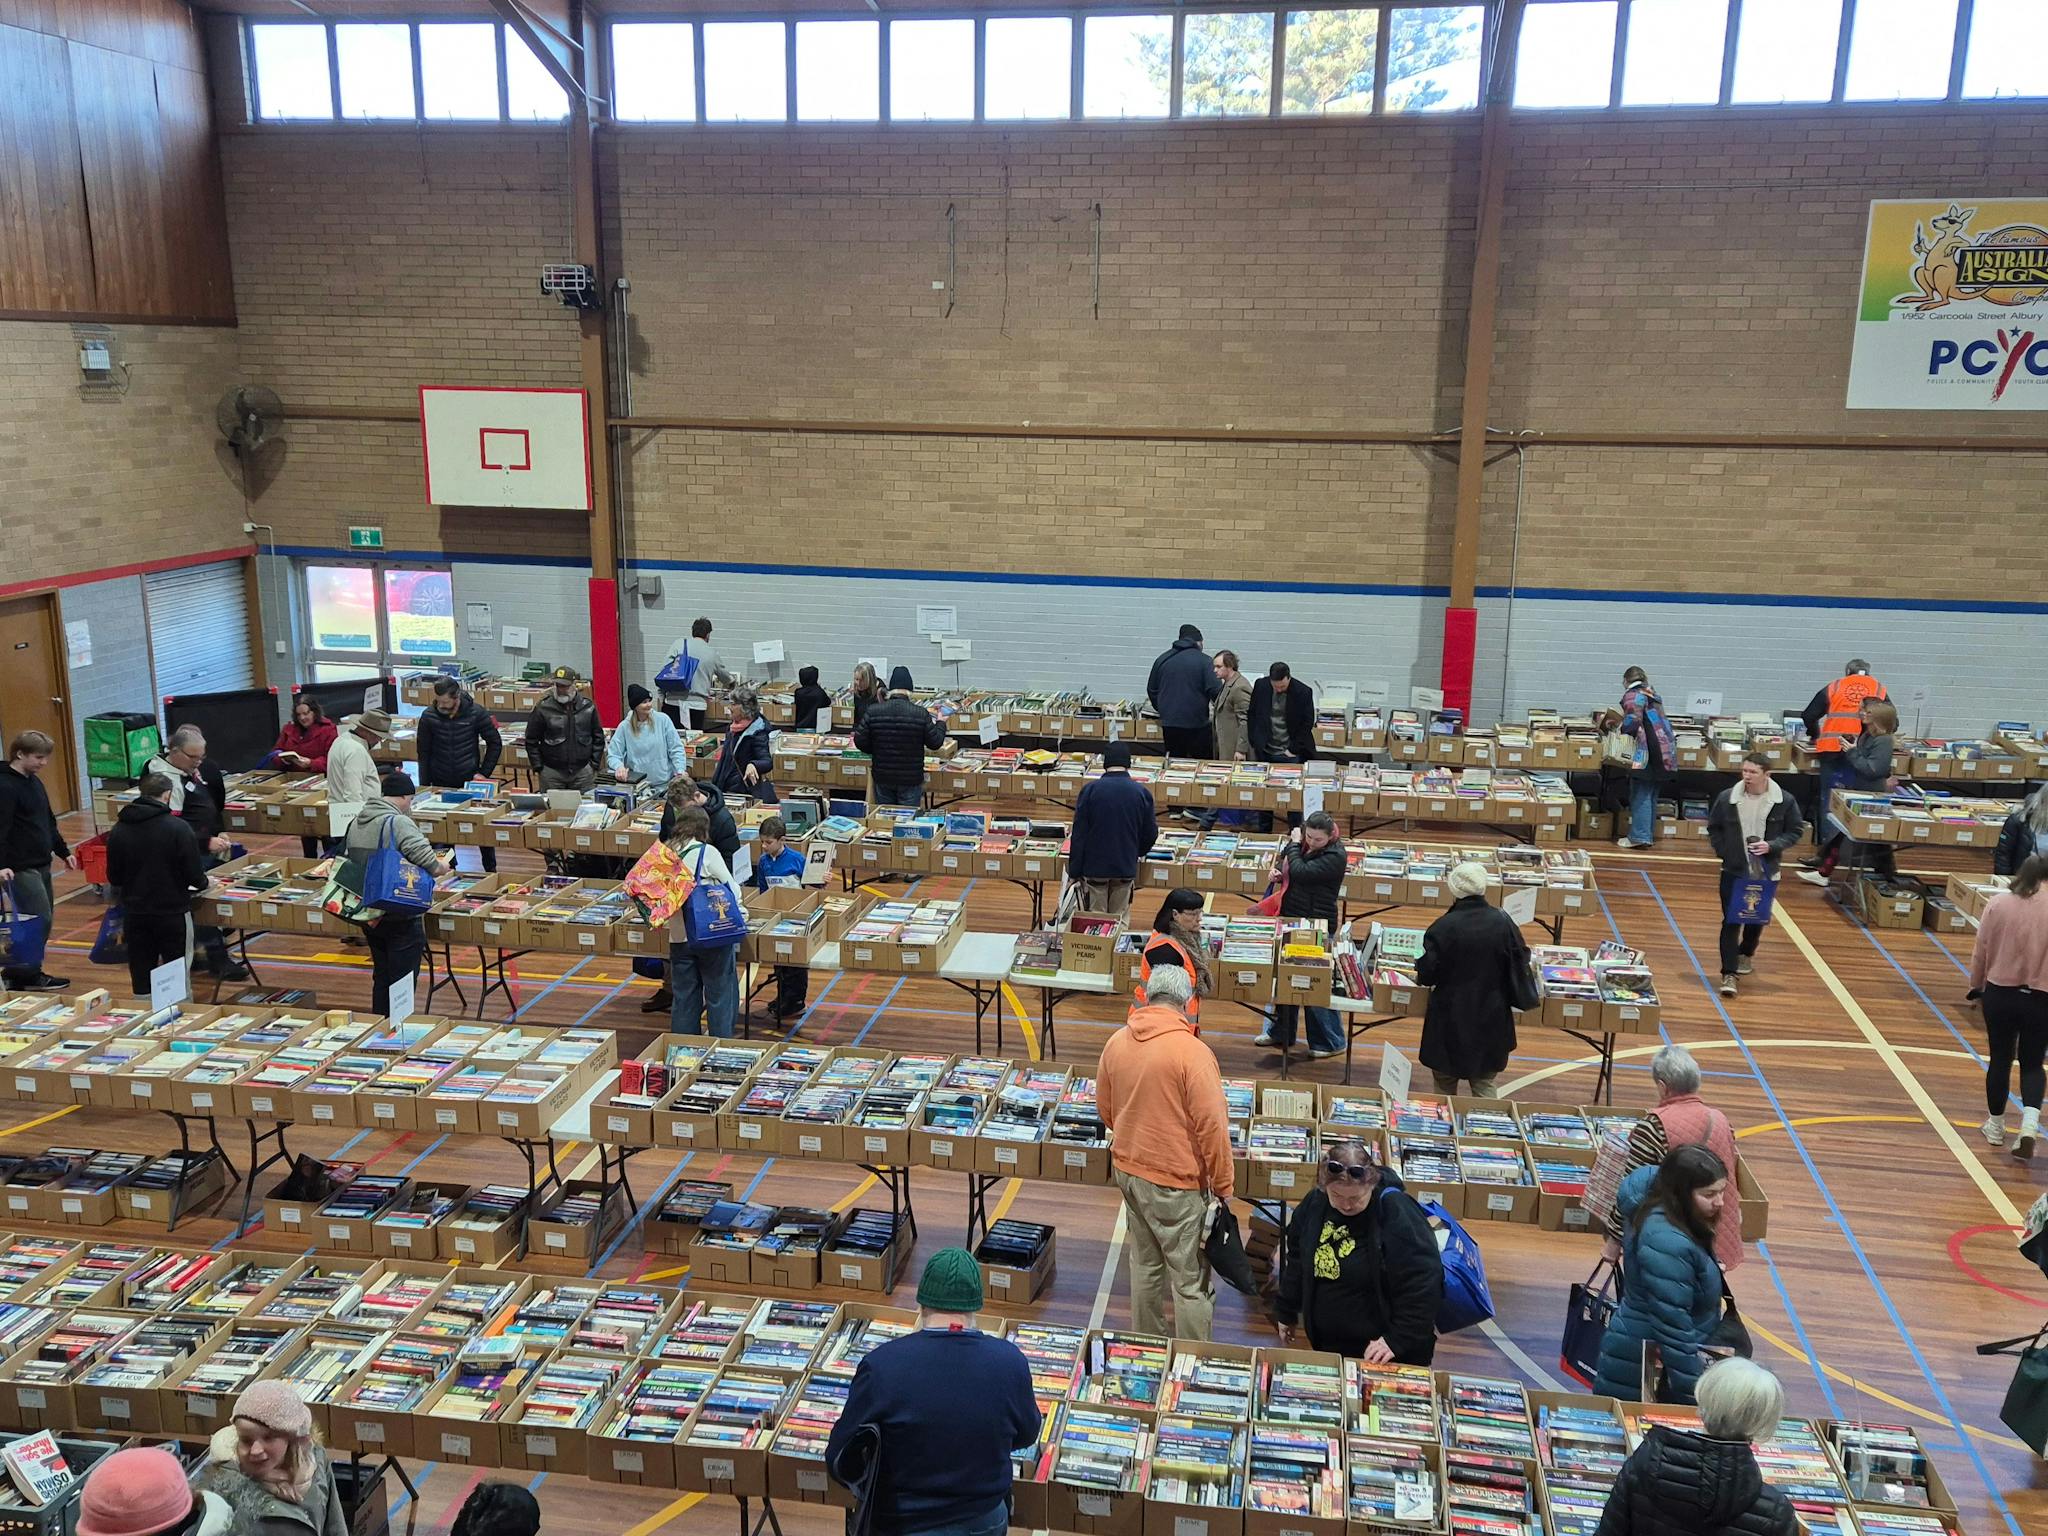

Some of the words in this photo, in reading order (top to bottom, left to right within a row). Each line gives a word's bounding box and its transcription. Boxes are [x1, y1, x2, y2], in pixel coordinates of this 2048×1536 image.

[1959, 250, 2048, 282] AUSTRALI
[1902, 312, 1925, 320] 1/952
[1929, 312, 1973, 320] Carcoola
[1977, 312, 2006, 320] Street
[2010, 312, 2043, 321] Albury
[1070, 942, 1102, 952] VICTORIAN
[1076, 951, 1096, 959] PEARS
[41, 1446, 55, 1457] We
[707, 1464, 728, 1473] CRIME
[34, 1472, 69, 1491] OSMAN
